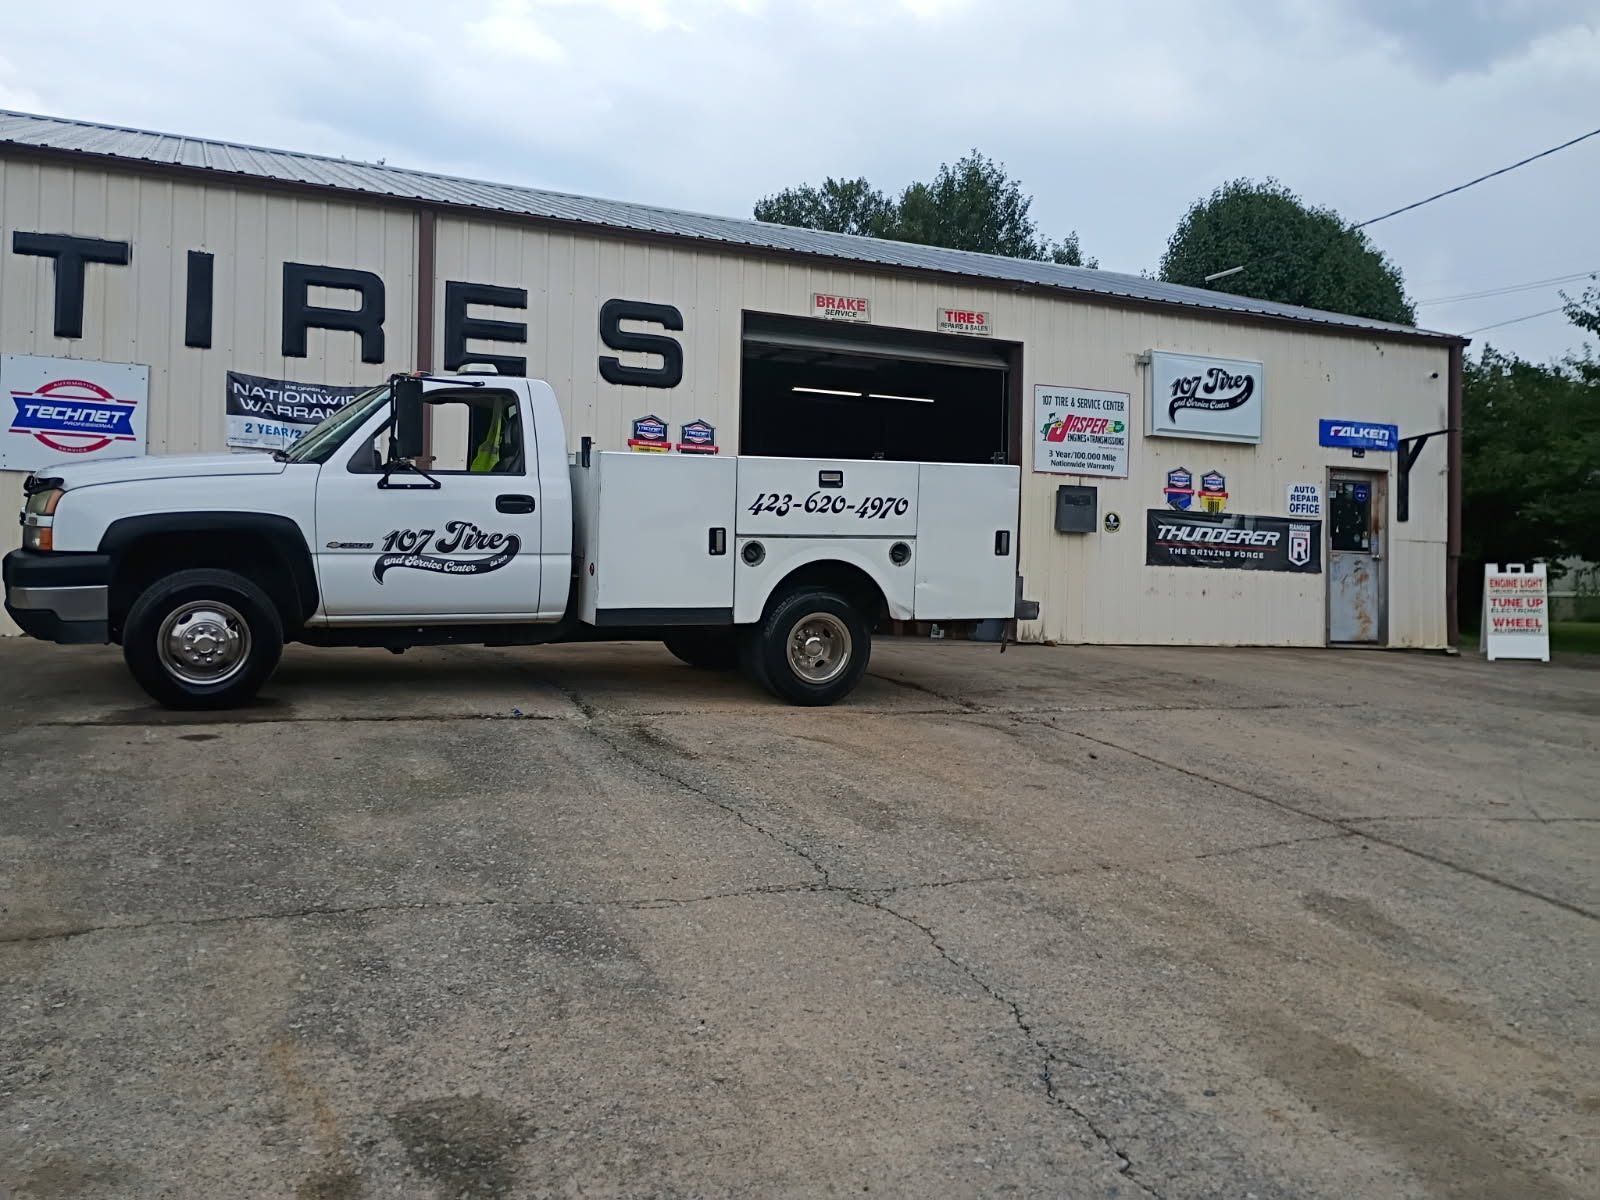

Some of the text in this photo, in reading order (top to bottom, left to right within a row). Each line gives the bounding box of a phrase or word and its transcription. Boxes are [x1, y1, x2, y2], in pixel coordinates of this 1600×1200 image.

[12, 230, 684, 388] TIRES
[816, 295, 865, 311] BRAKE
[825, 309, 857, 318] SERVICE
[945, 310, 984, 324] TIRES
[940, 322, 963, 330] REPAIRS
[53, 381, 97, 390] AUTOMOTIVE
[1171, 367, 1244, 398] 107 Tire
[1042, 395, 1125, 411] 107 TIRE & SERVICE CENTER
[1173, 399, 1230, 409] and Service Center
[24, 405, 126, 424] TECHNET
[63, 421, 114, 429] PROFESSIONAL
[245, 422, 253, 433] 2
[1047, 414, 1109, 442] JASPER
[1330, 425, 1389, 440] FALKEN
[1067, 433, 1125, 446] ENGINES TRANSMISSIONS
[1048, 449, 1054, 457] 3
[1101, 453, 1117, 462] Mile
[1050, 459, 1115, 472] Nationwide Warranty
[1294, 486, 1316, 494] AUTO
[748, 491, 909, 519] 423-620-4970
[1290, 494, 1319, 503] REPAIR
[1289, 503, 1320, 514] OFFICE
[382, 520, 504, 557] 107 Tire
[1157, 525, 1281, 546] THUNDERER
[1168, 547, 1264, 559] THE DRIVING FORCE
[383, 554, 477, 572] and Service Center
[1489, 579, 1517, 587] ENGINE
[1490, 598, 1543, 607] TUNE UP
[1492, 617, 1542, 628] WHEEL
